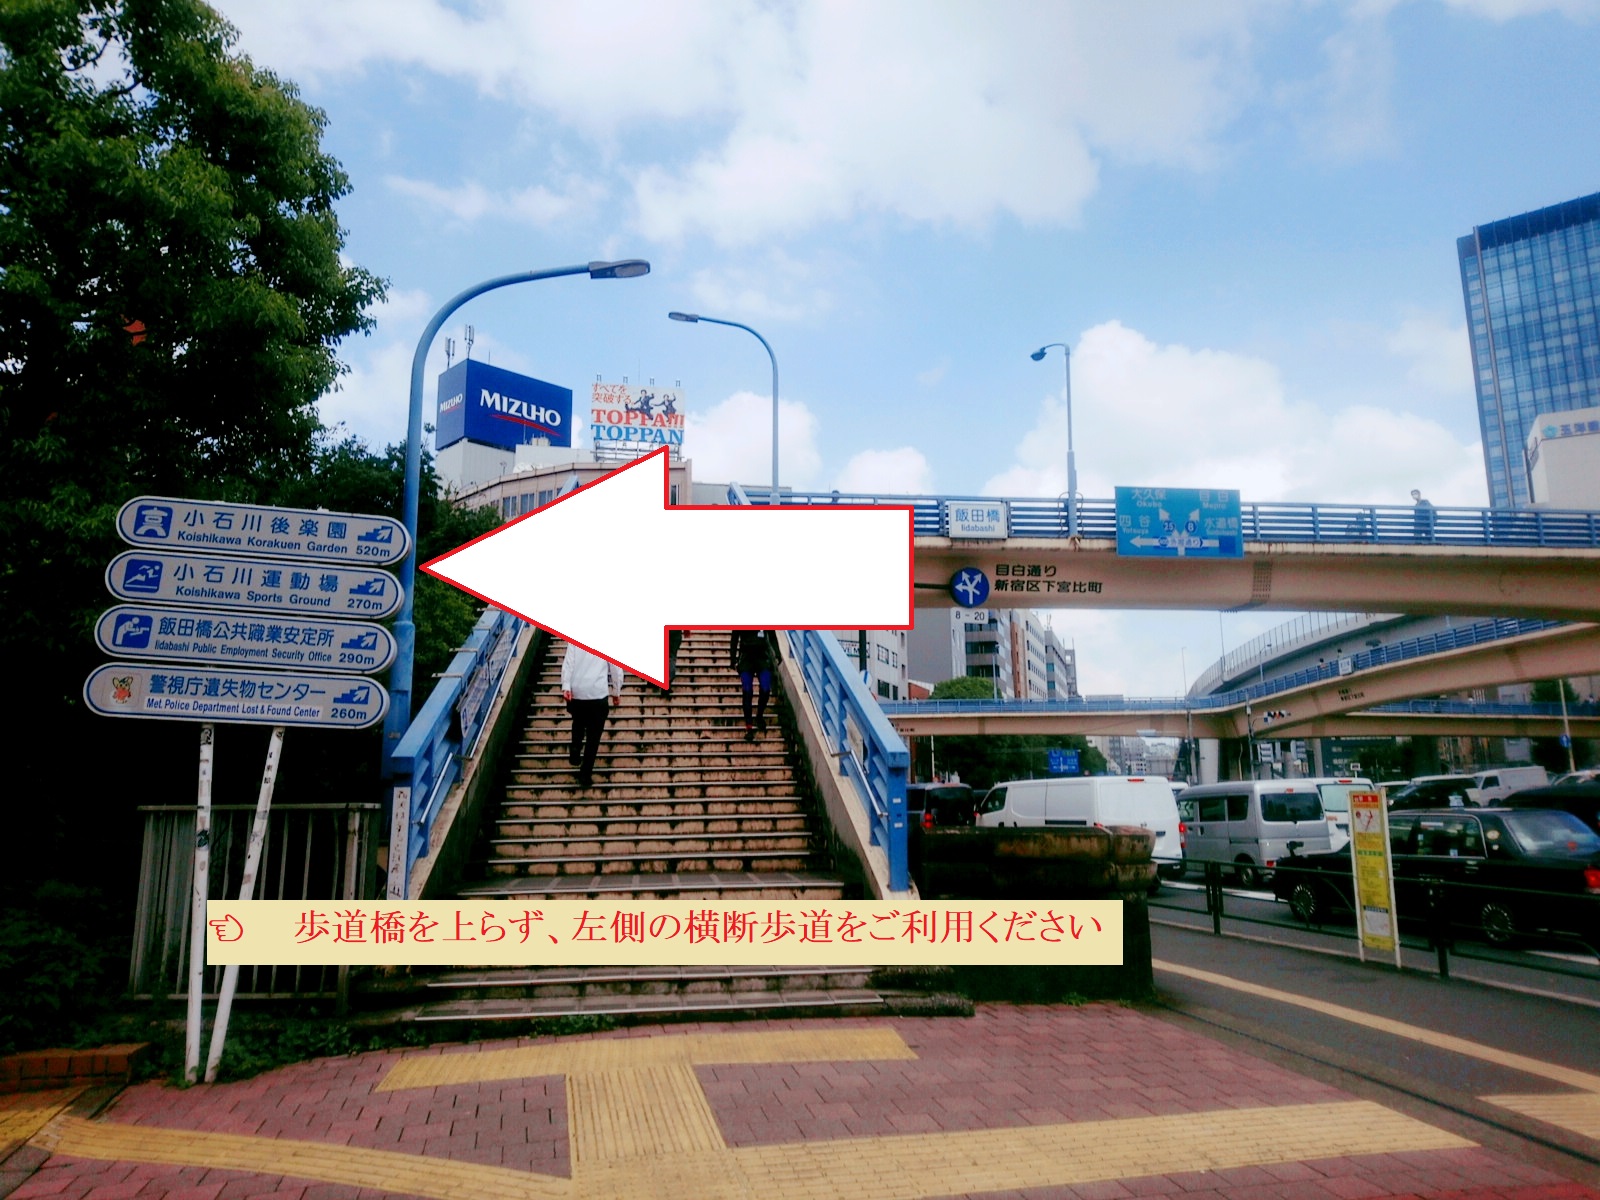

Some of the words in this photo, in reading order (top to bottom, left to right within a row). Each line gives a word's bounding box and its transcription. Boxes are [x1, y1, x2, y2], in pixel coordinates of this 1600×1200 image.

[439, 393, 463, 413] MIZUHO
[480, 388, 562, 427] MIZUHO
[590, 424, 685, 445] TOPPAN
[183, 509, 347, 540] 小石川後楽園
[955, 508, 1000, 523] 飯田橋
[961, 524, 996, 533] Iidabashi
[177, 530, 242, 546] Koishikawa
[247, 536, 301, 551] Korakuen
[306, 541, 348, 554] Garden
[355, 544, 391, 558] 520m
[173, 563, 339, 593] 小石川運動場
[995, 564, 1057, 577] 目白通り
[175, 586, 241, 600] Koishikawa
[246, 590, 283, 604] Sports
[289, 594, 331, 607] Ground
[347, 598, 383, 610] 270m
[994, 579, 1104, 594] 新宿区下宮比町
[158, 616, 335, 648] 飯田橋公共職業安定所
[154, 640, 190, 652] Iidabashi
[192, 642, 217, 654] Public
[220, 644, 268, 660] Employment
[271, 648, 305, 662] Security
[308, 651, 332, 663] Office
[338, 652, 375, 665] 290m
[150, 673, 326, 701] 警視庁遺失物センター
[164, 699, 190, 711] Police
[192, 700, 240, 715] Department
[241, 704, 260, 715] Lost
[266, 705, 292, 716] Found
[293, 706, 320, 718] Center
[330, 707, 367, 720] 260m
